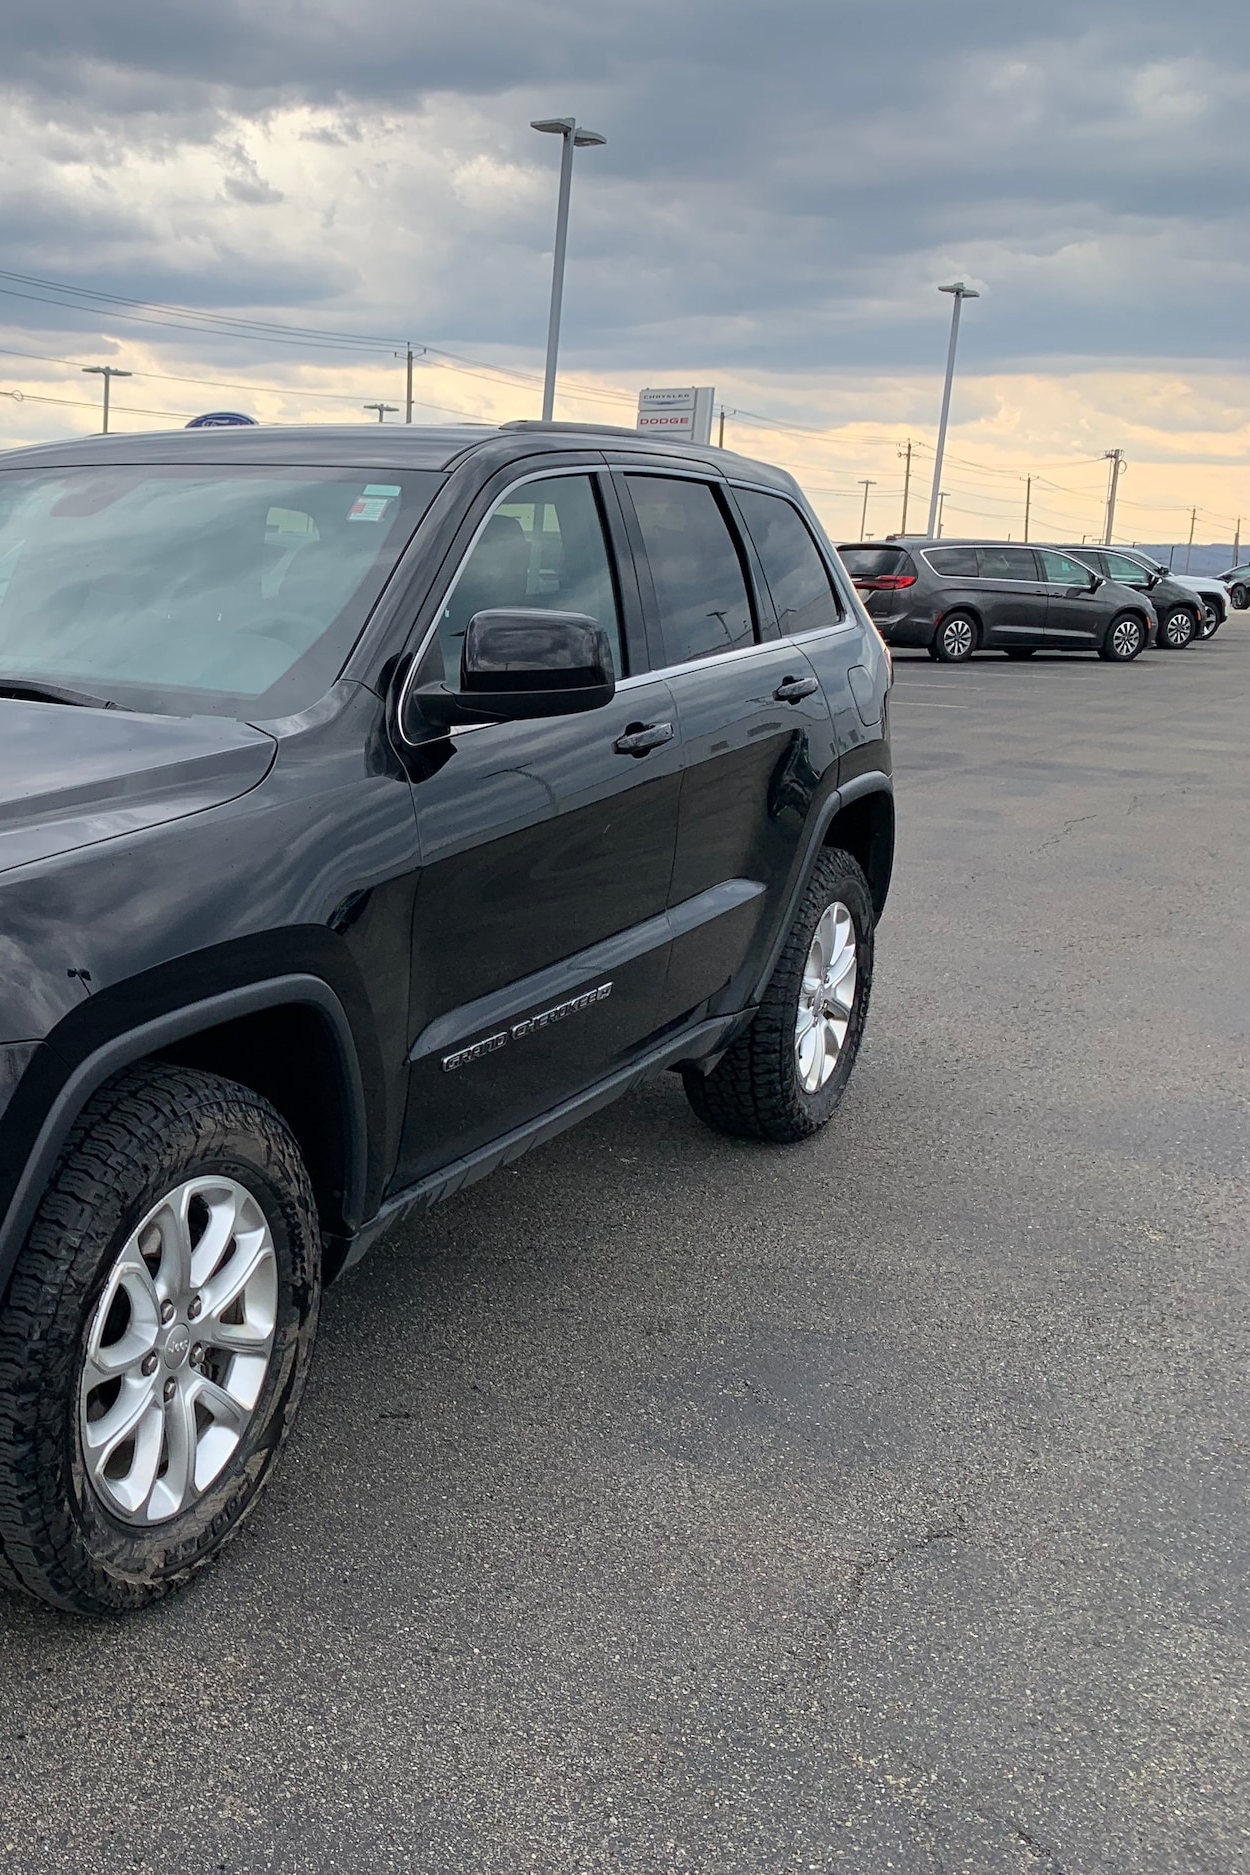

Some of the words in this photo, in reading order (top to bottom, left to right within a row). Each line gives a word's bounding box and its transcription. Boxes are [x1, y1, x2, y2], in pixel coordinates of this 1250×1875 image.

[640, 417, 689, 425] DODGE
[441, 1031, 509, 1073] GRAND
[510, 989, 598, 1040] CHEROKEE
